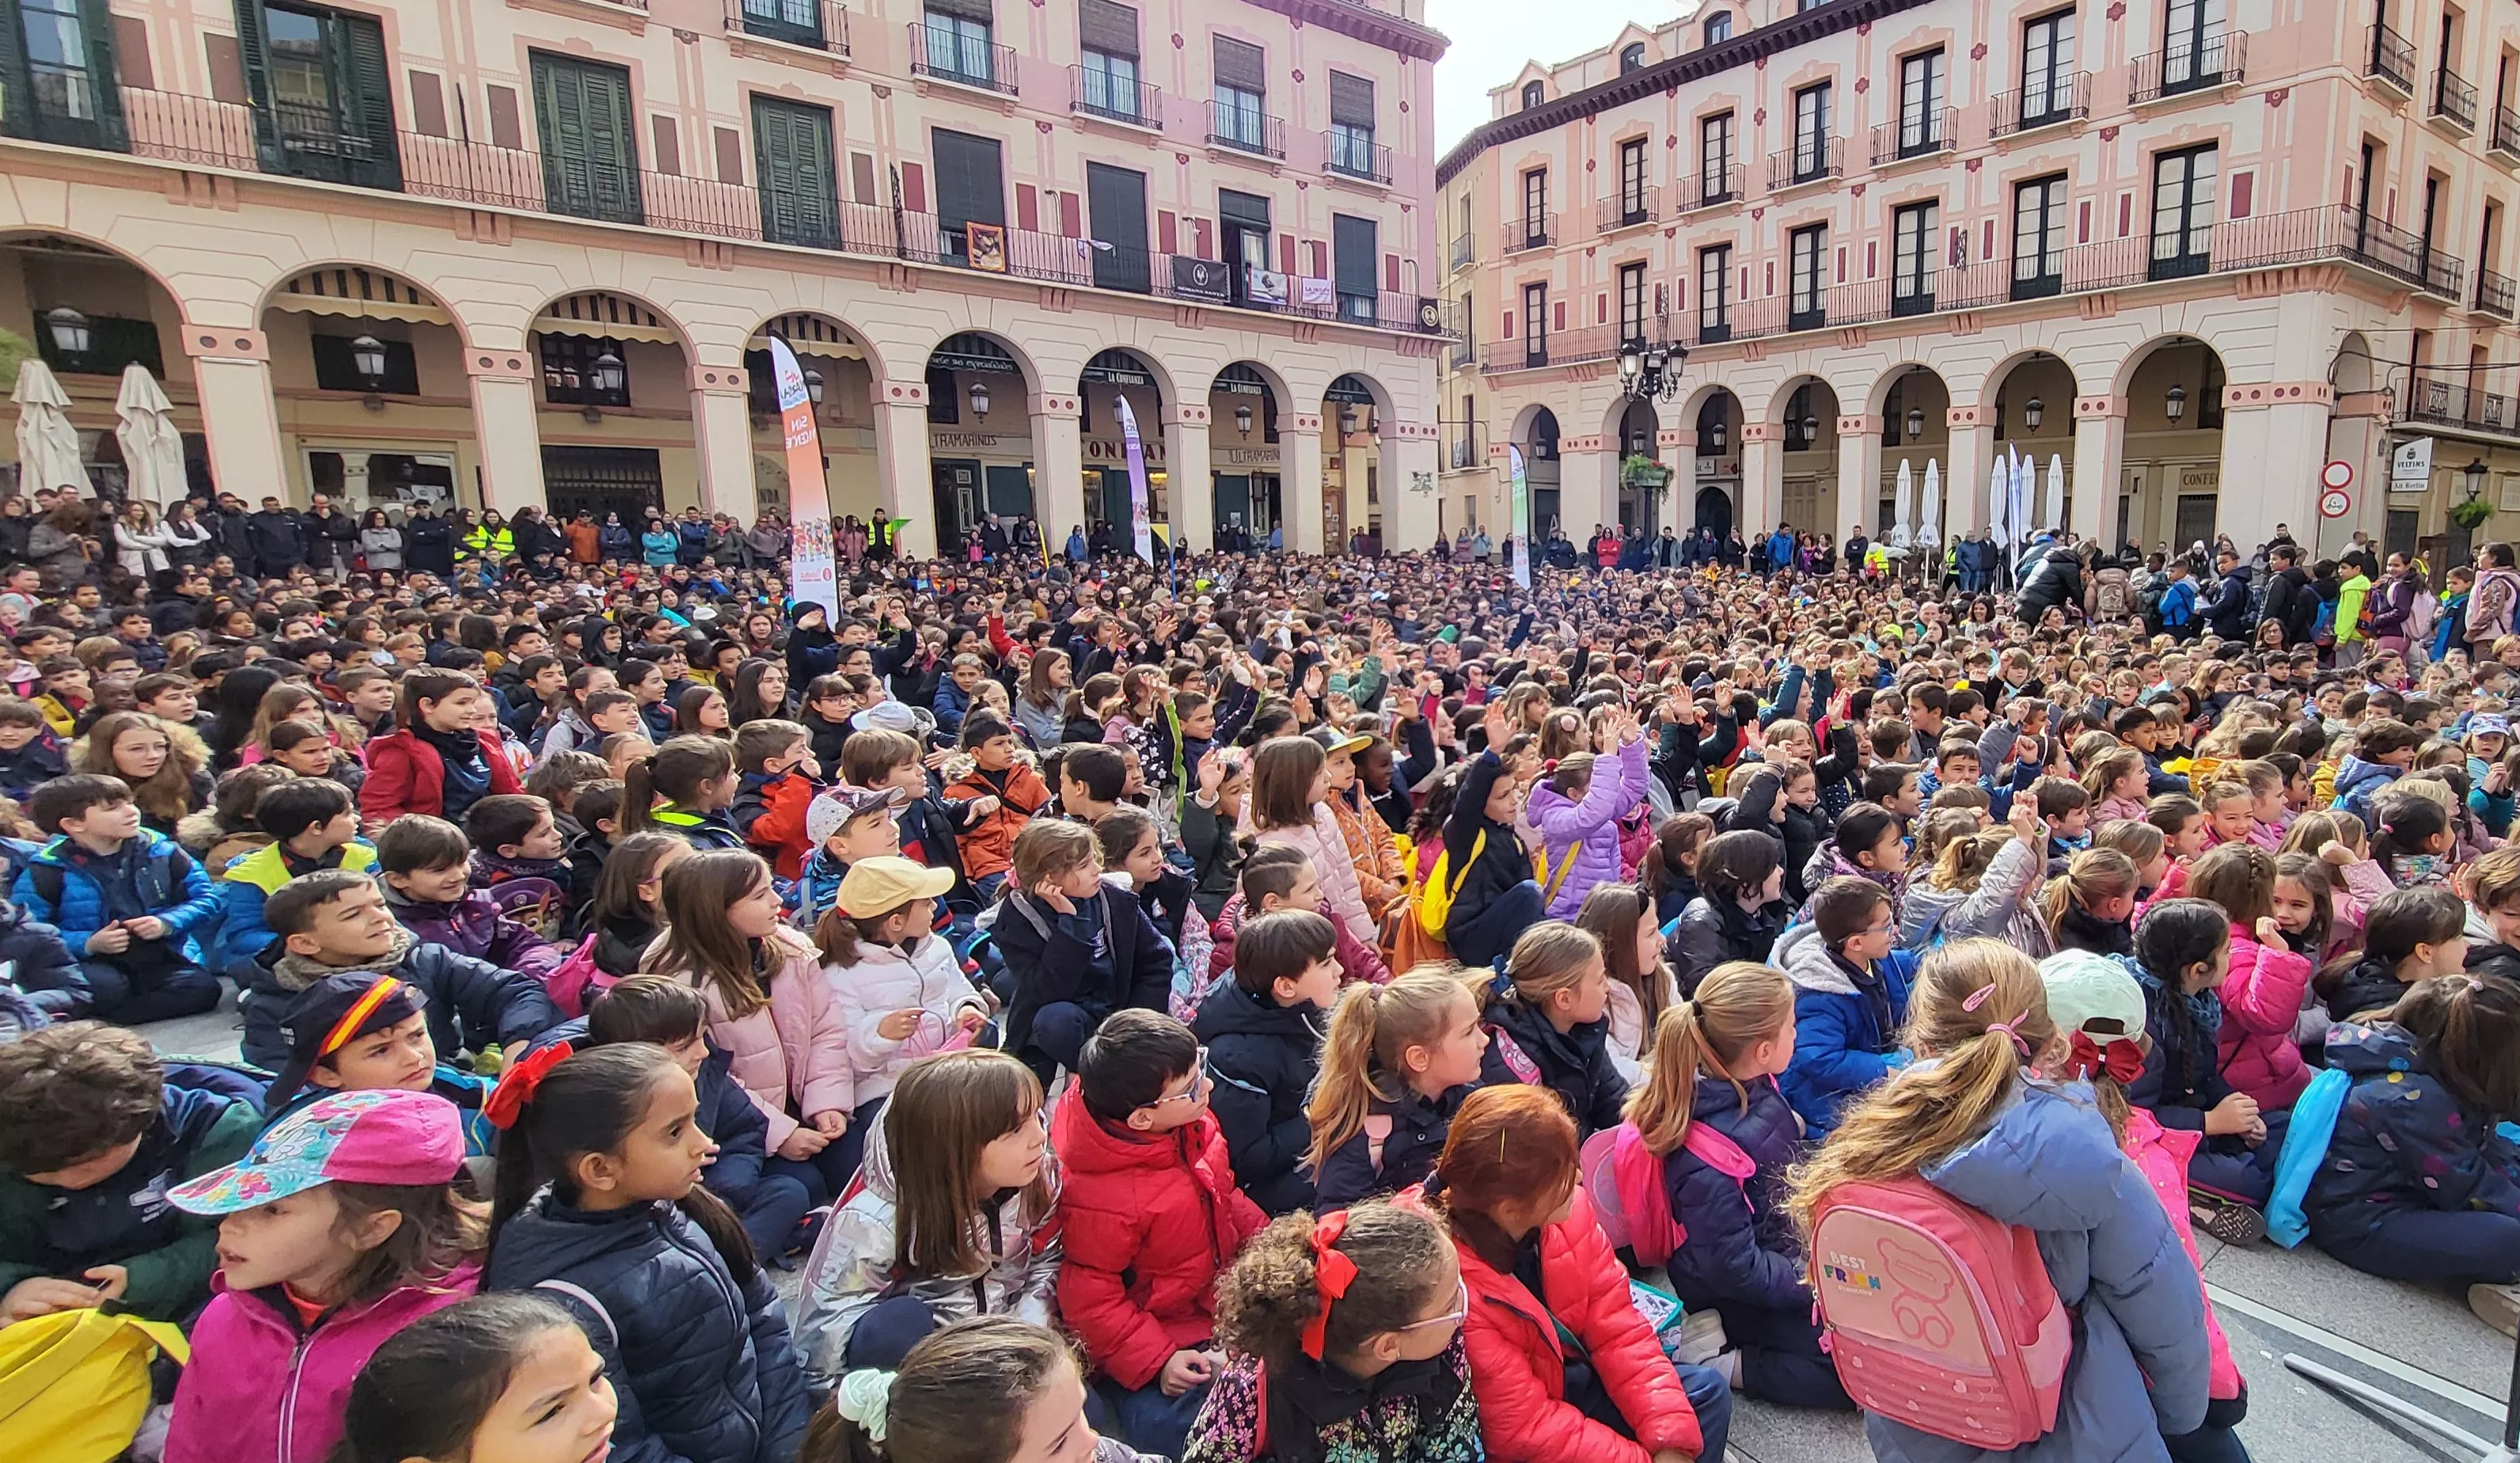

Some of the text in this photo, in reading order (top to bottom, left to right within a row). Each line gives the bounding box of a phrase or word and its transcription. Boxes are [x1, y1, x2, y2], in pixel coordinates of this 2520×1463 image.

[1108, 371, 1115, 383] LA
[1230, 382, 1237, 393] LA
[1829, 1251, 1866, 1271] BEST
